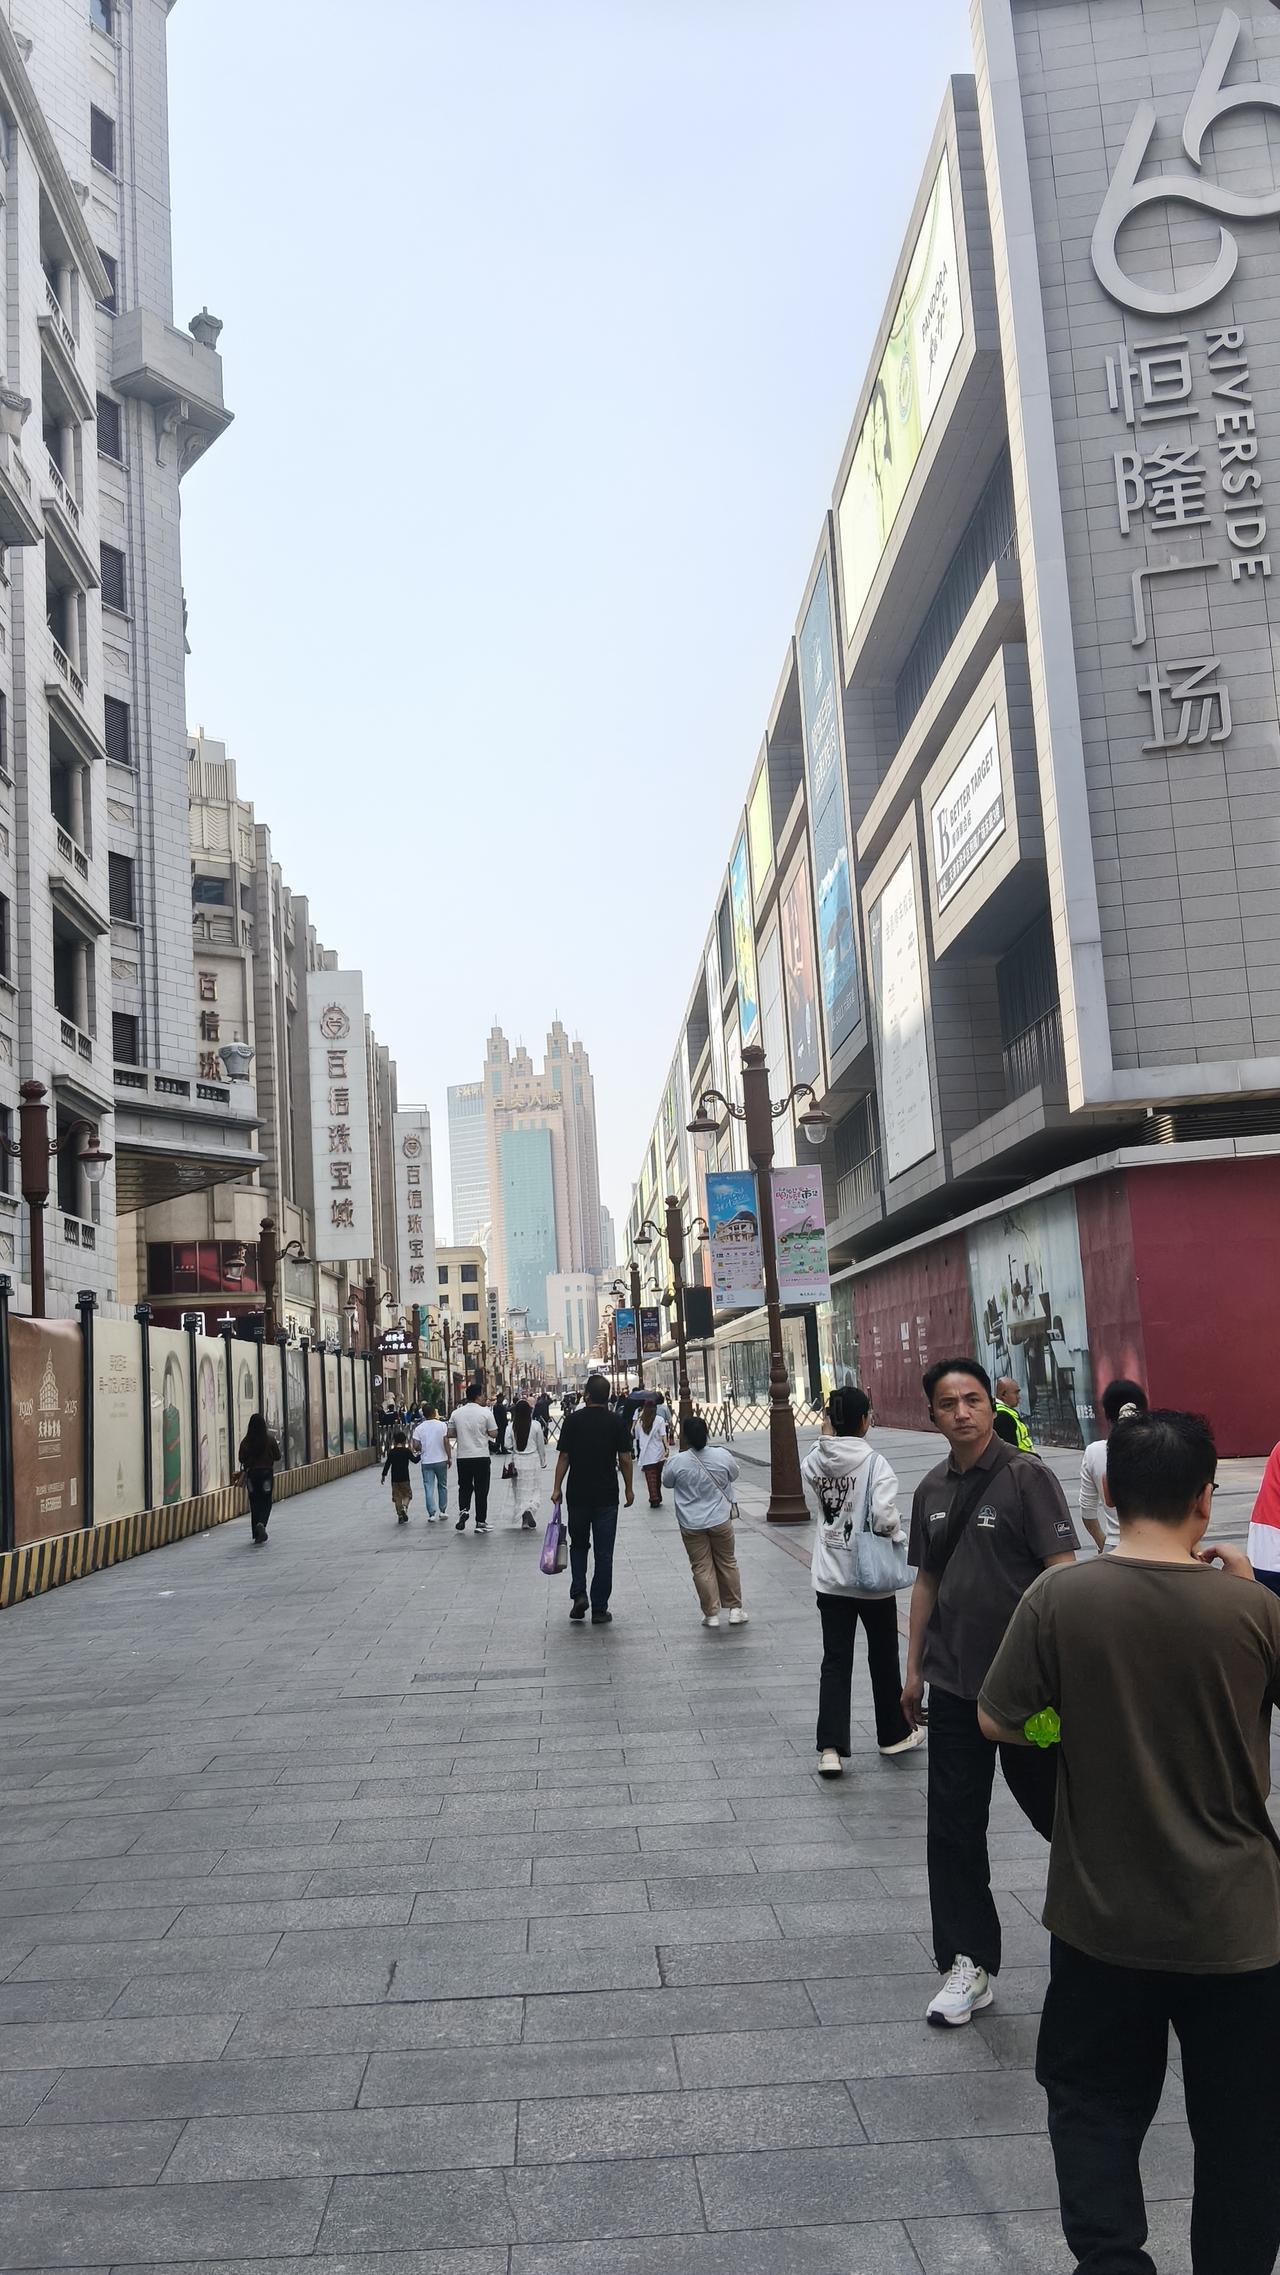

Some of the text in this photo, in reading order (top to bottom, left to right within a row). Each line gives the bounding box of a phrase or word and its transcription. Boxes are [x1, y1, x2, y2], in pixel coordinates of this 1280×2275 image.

[922, 261, 949, 342] PANDORA
[1205, 323, 1272, 582] RIVERSIDE
[1105, 334, 1235, 753] 恒隆广场
[950, 784, 971, 828] BETTER
[970, 746, 994, 797] TARGET
[327, 1050, 355, 1228] 百信珠宝城
[407, 1165, 426, 1285] 百信珠宝城
